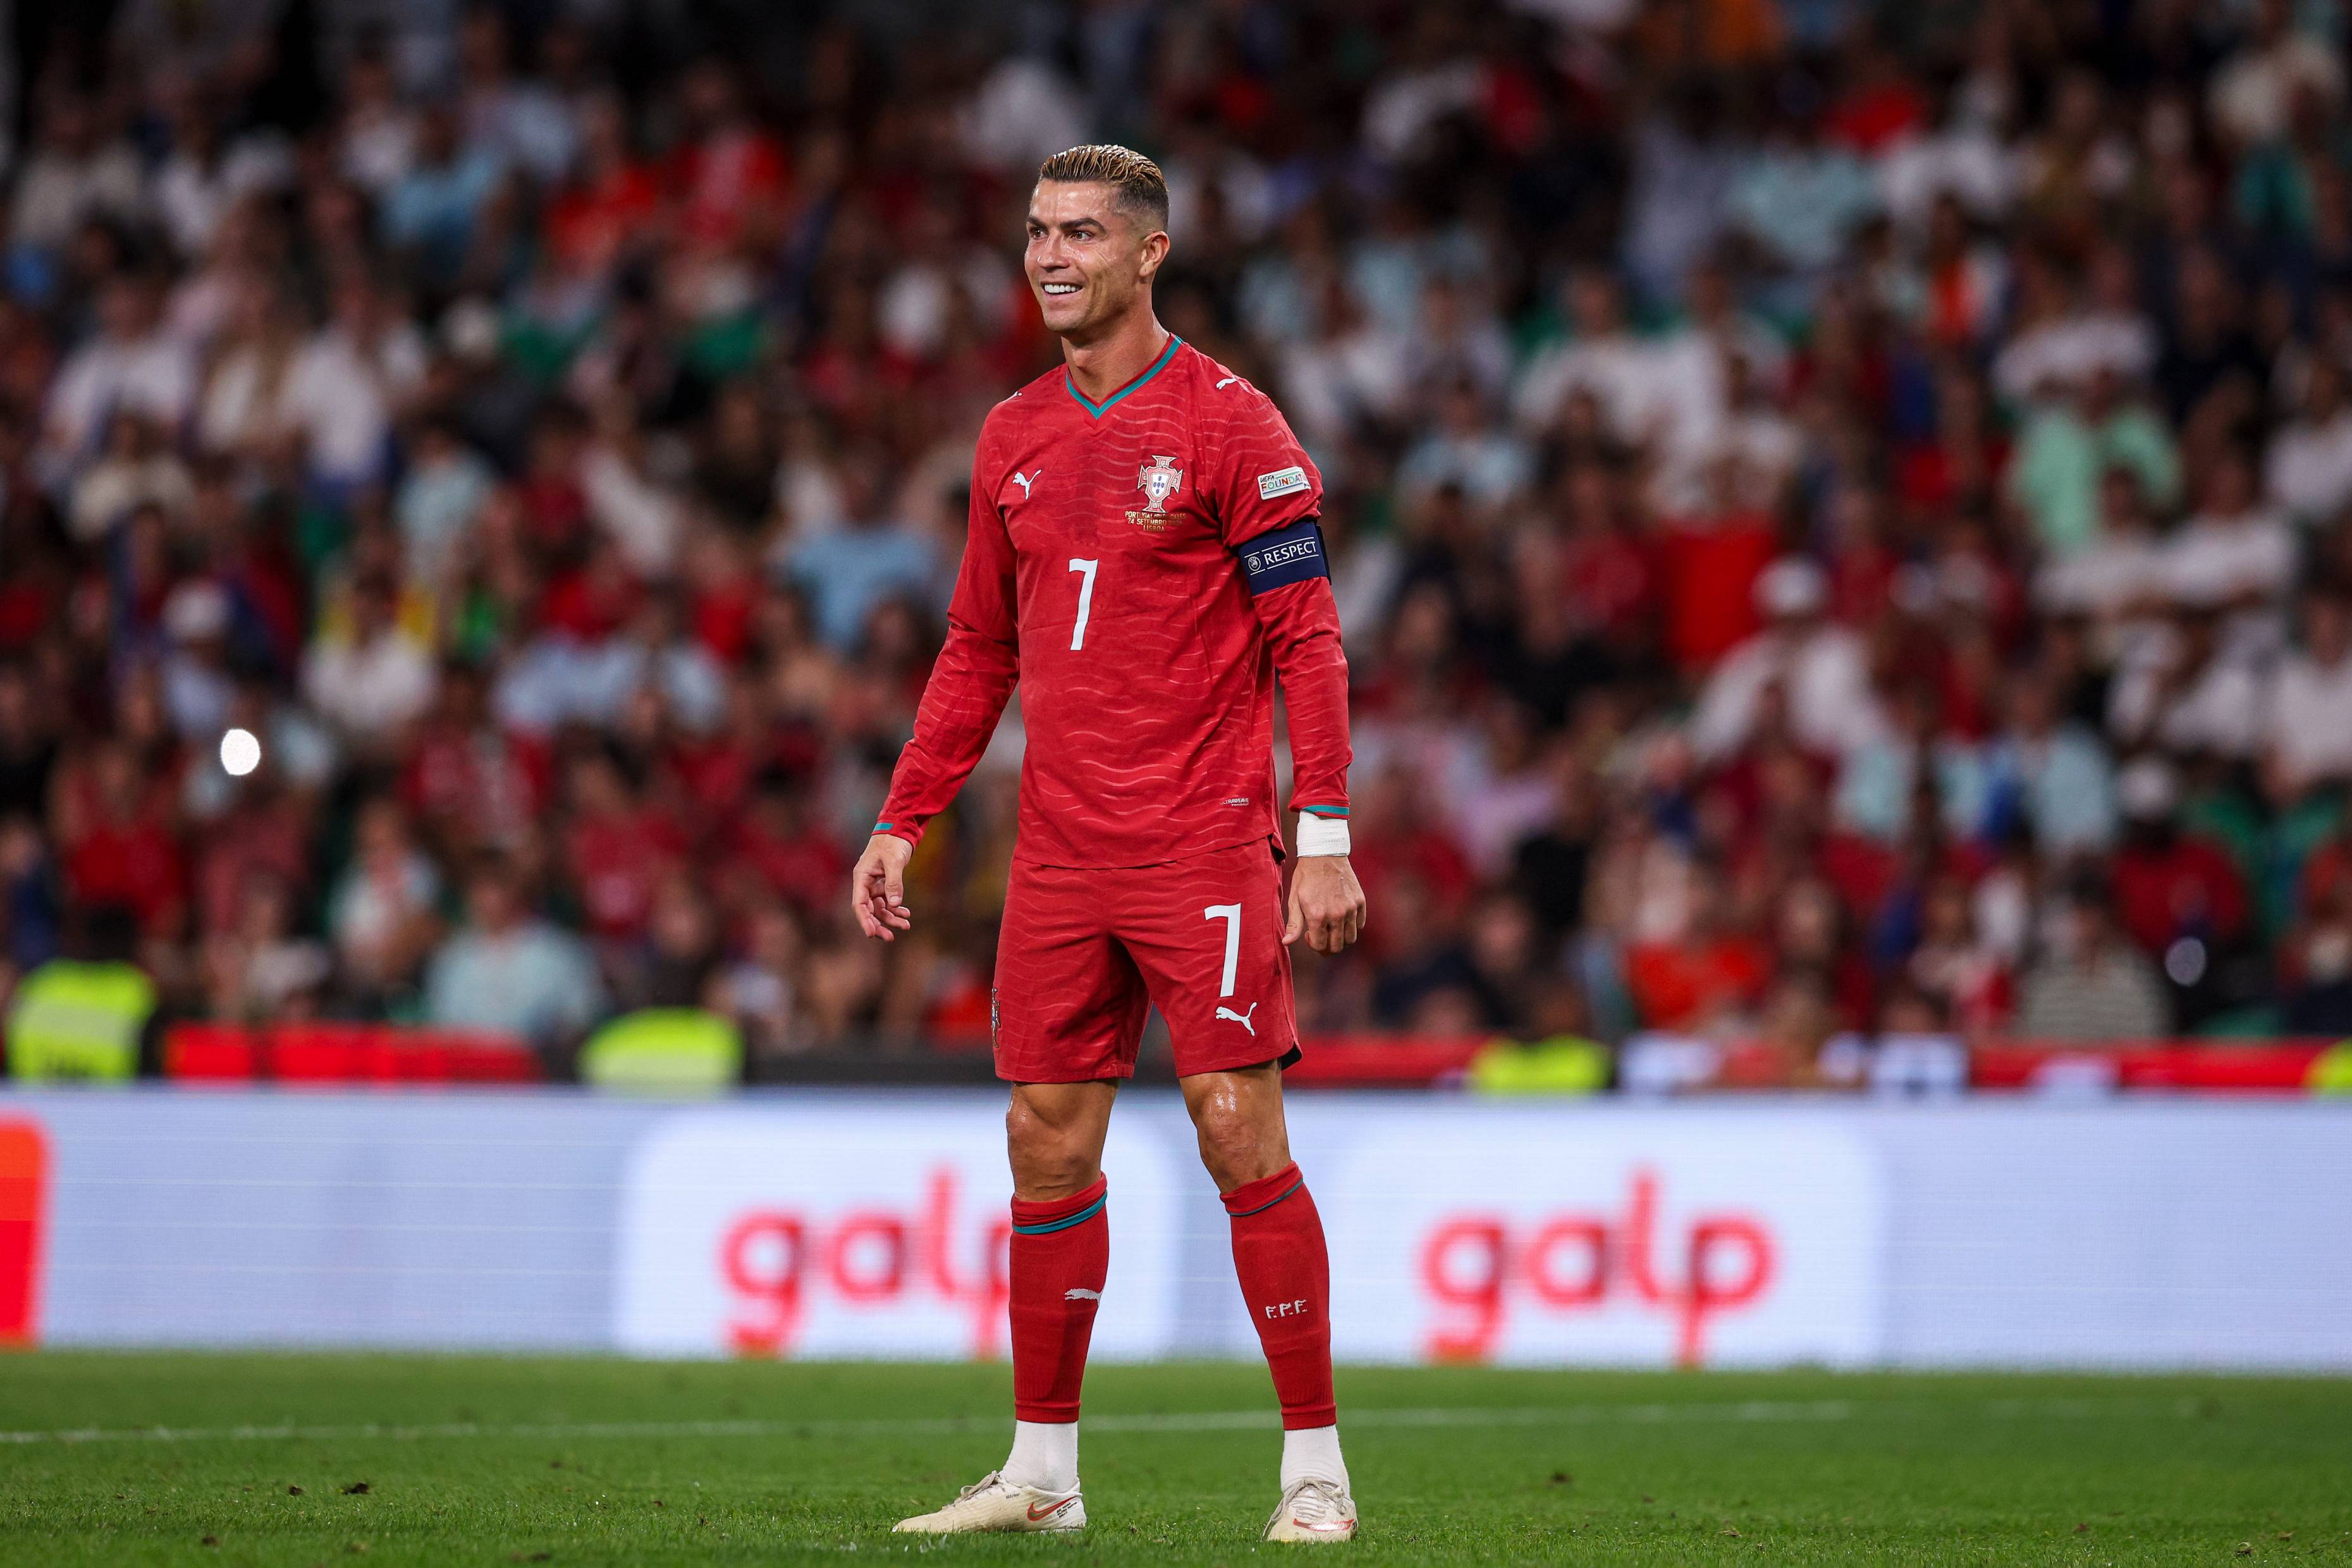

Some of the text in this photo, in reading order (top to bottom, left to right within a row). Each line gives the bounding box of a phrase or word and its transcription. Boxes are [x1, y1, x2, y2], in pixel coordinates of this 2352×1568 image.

[1264, 541, 1316, 565] RESPECT
[1069, 558, 1099, 651] 7
[1204, 902, 1242, 998] 7
[1265, 1299, 1308, 1320] F.P.F.
[1420, 1167, 1779, 1368] galp
